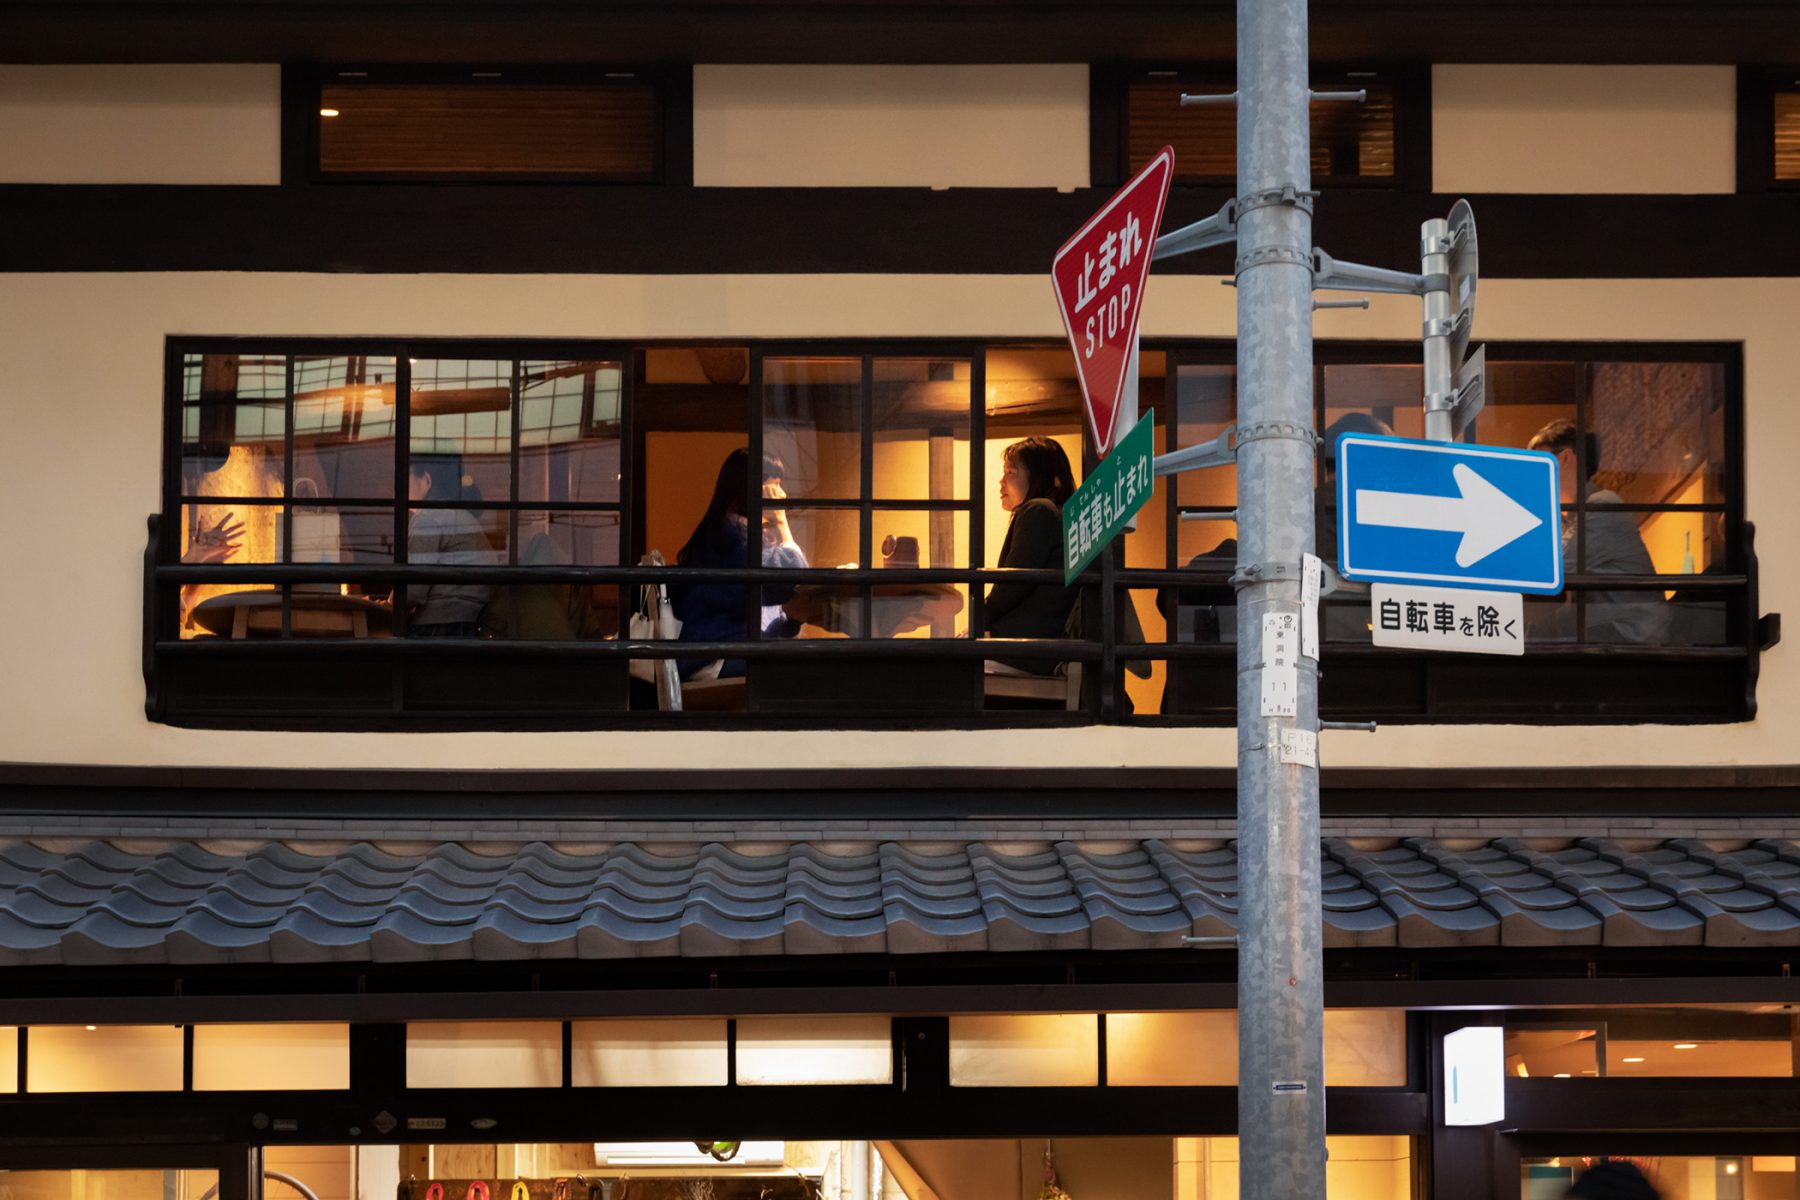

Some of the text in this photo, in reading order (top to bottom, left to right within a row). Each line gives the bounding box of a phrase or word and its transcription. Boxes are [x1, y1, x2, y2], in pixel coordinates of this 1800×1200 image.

[1074, 211, 1143, 314] 止まれ
[1085, 283, 1131, 360] STOP
[1068, 455, 1149, 569] 自転車も止まれ
[1380, 598, 1517, 640] 自転車を除く
